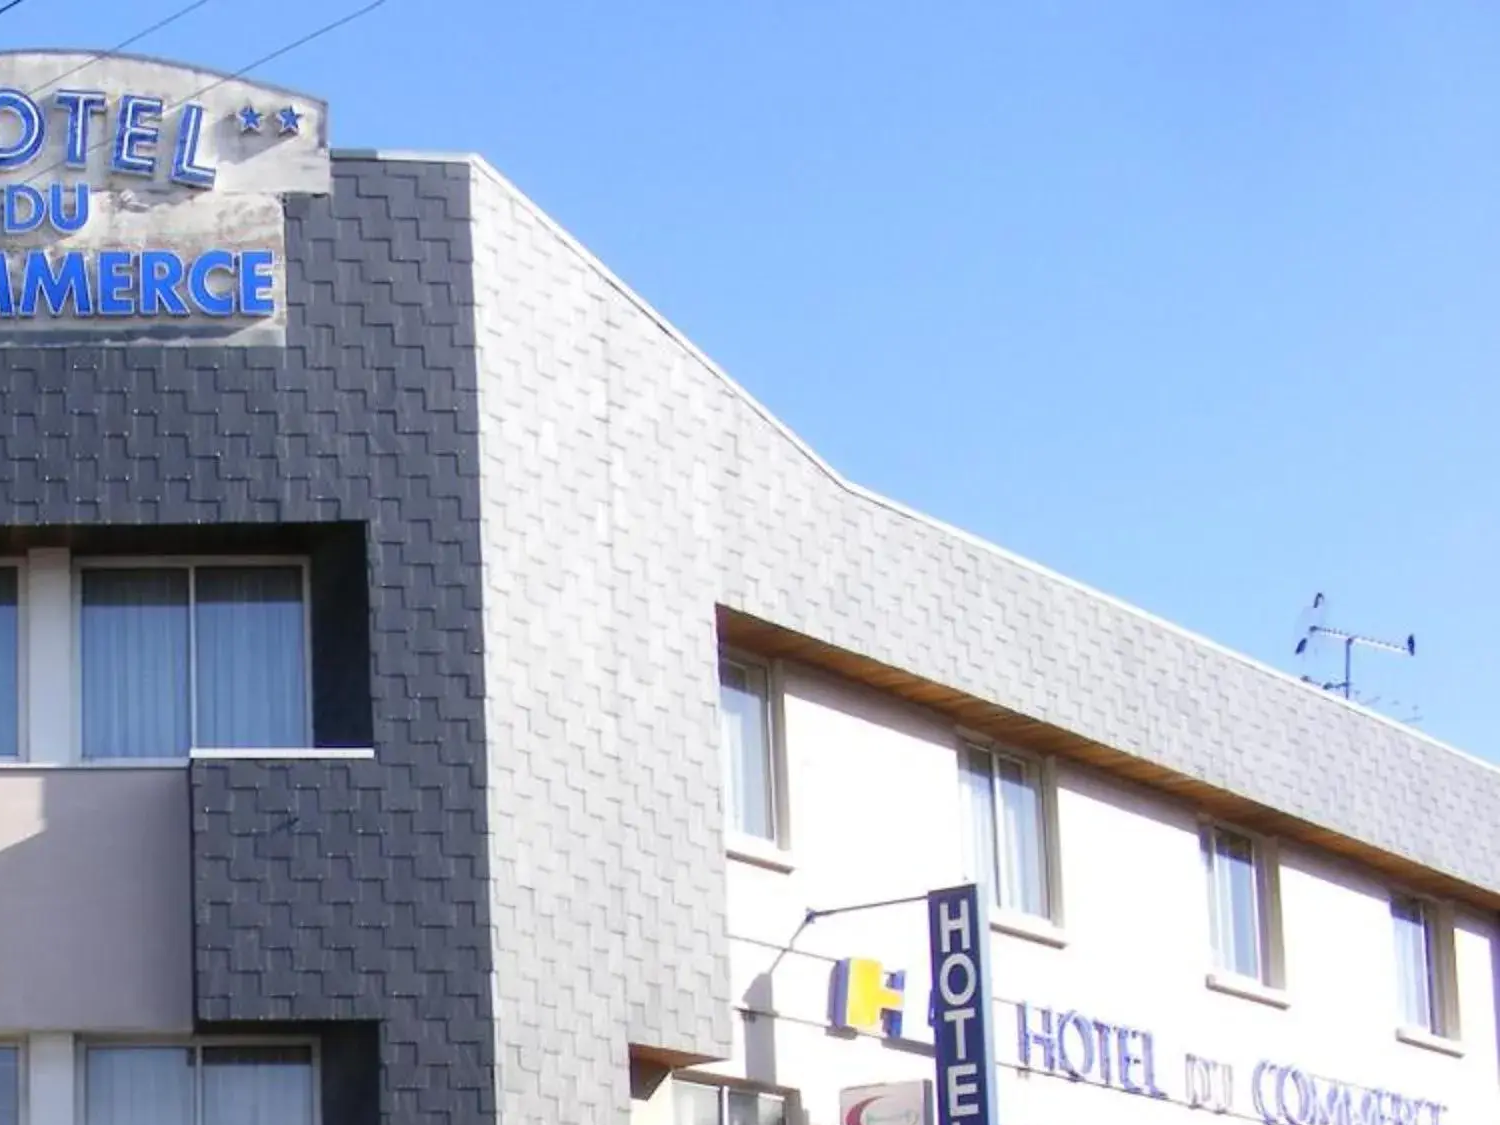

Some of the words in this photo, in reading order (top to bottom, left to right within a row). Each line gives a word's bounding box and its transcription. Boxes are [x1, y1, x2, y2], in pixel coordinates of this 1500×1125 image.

[3, 182, 90, 235] DU
[1015, 1000, 1169, 1100] HOTEL
[1184, 1052, 1234, 1112] DU
